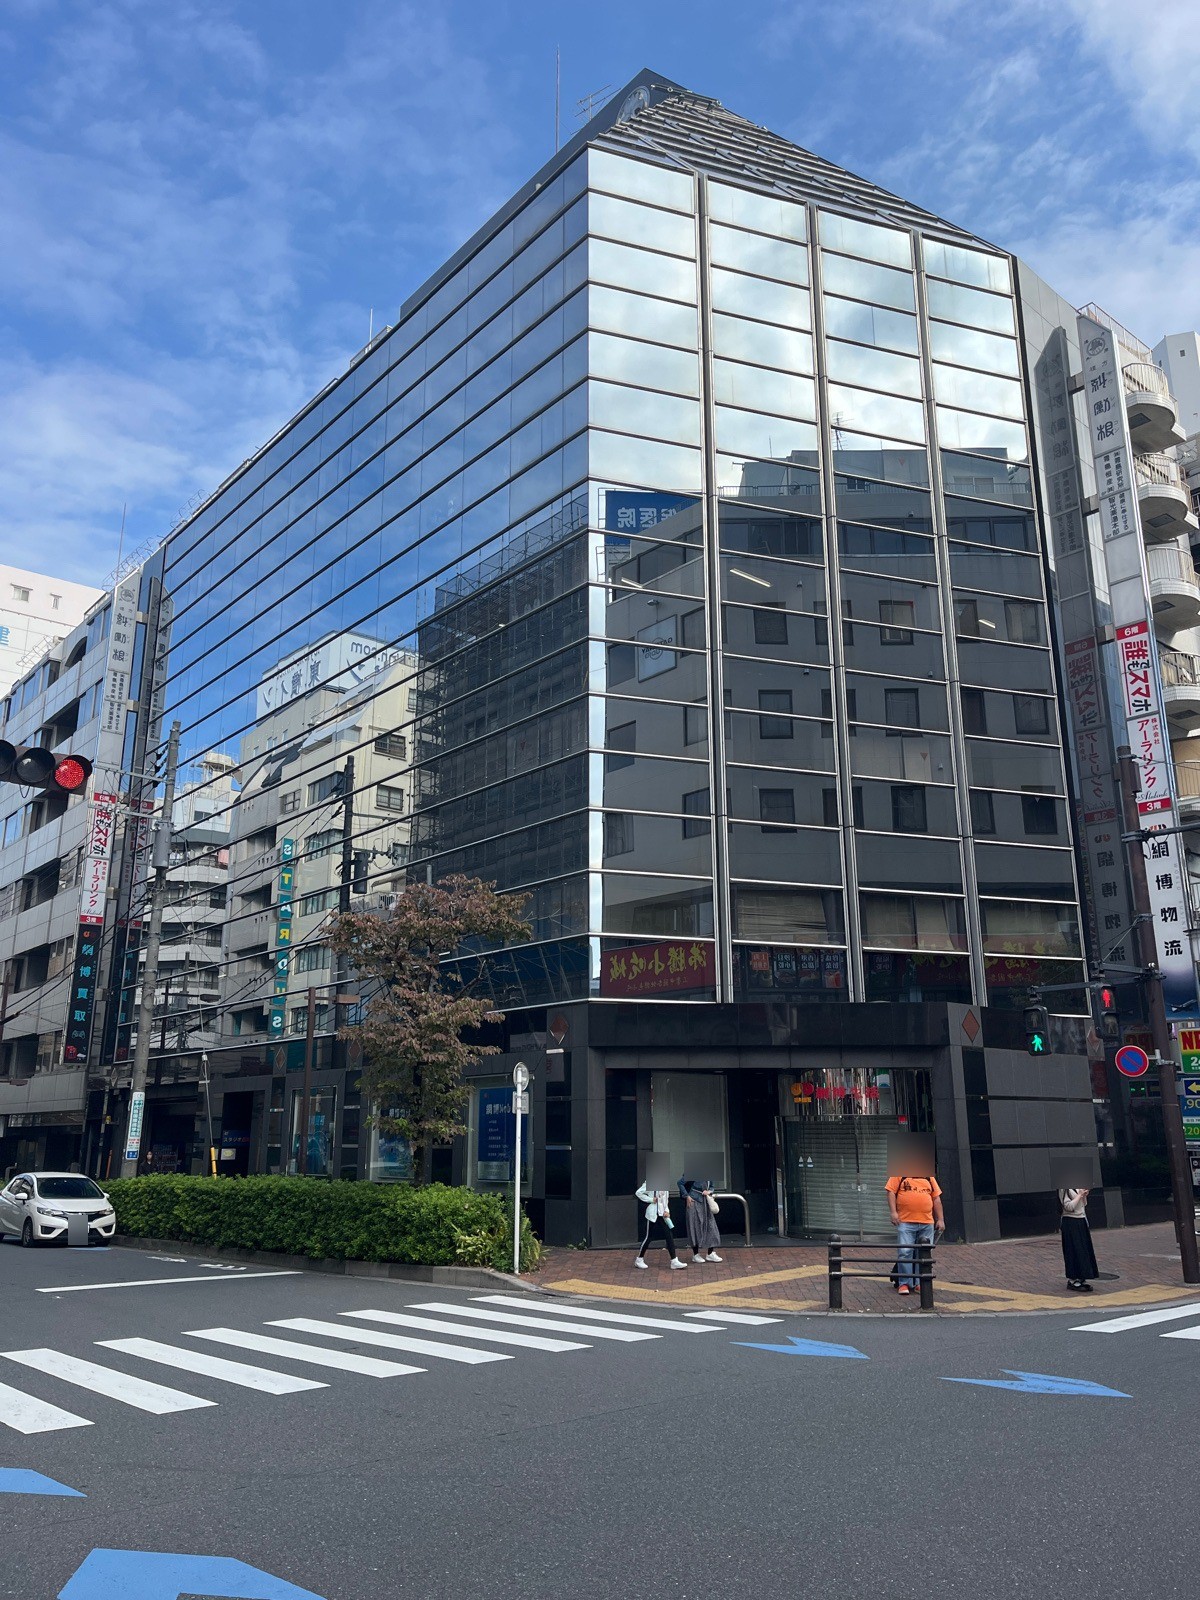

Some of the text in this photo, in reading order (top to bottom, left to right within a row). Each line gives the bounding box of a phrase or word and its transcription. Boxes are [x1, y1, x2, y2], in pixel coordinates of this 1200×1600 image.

[1123, 625, 1139, 637] 6階
[1150, 717, 1160, 746] 株式会社
[1137, 718, 1157, 788] アーラリンク
[1146, 802, 1162, 812] 3階
[89, 859, 102, 908] アーラリンク
[1150, 840, 1183, 957] 網博物流
[86, 916, 97, 924] 3階
[74, 943, 95, 1022] 網博買取
